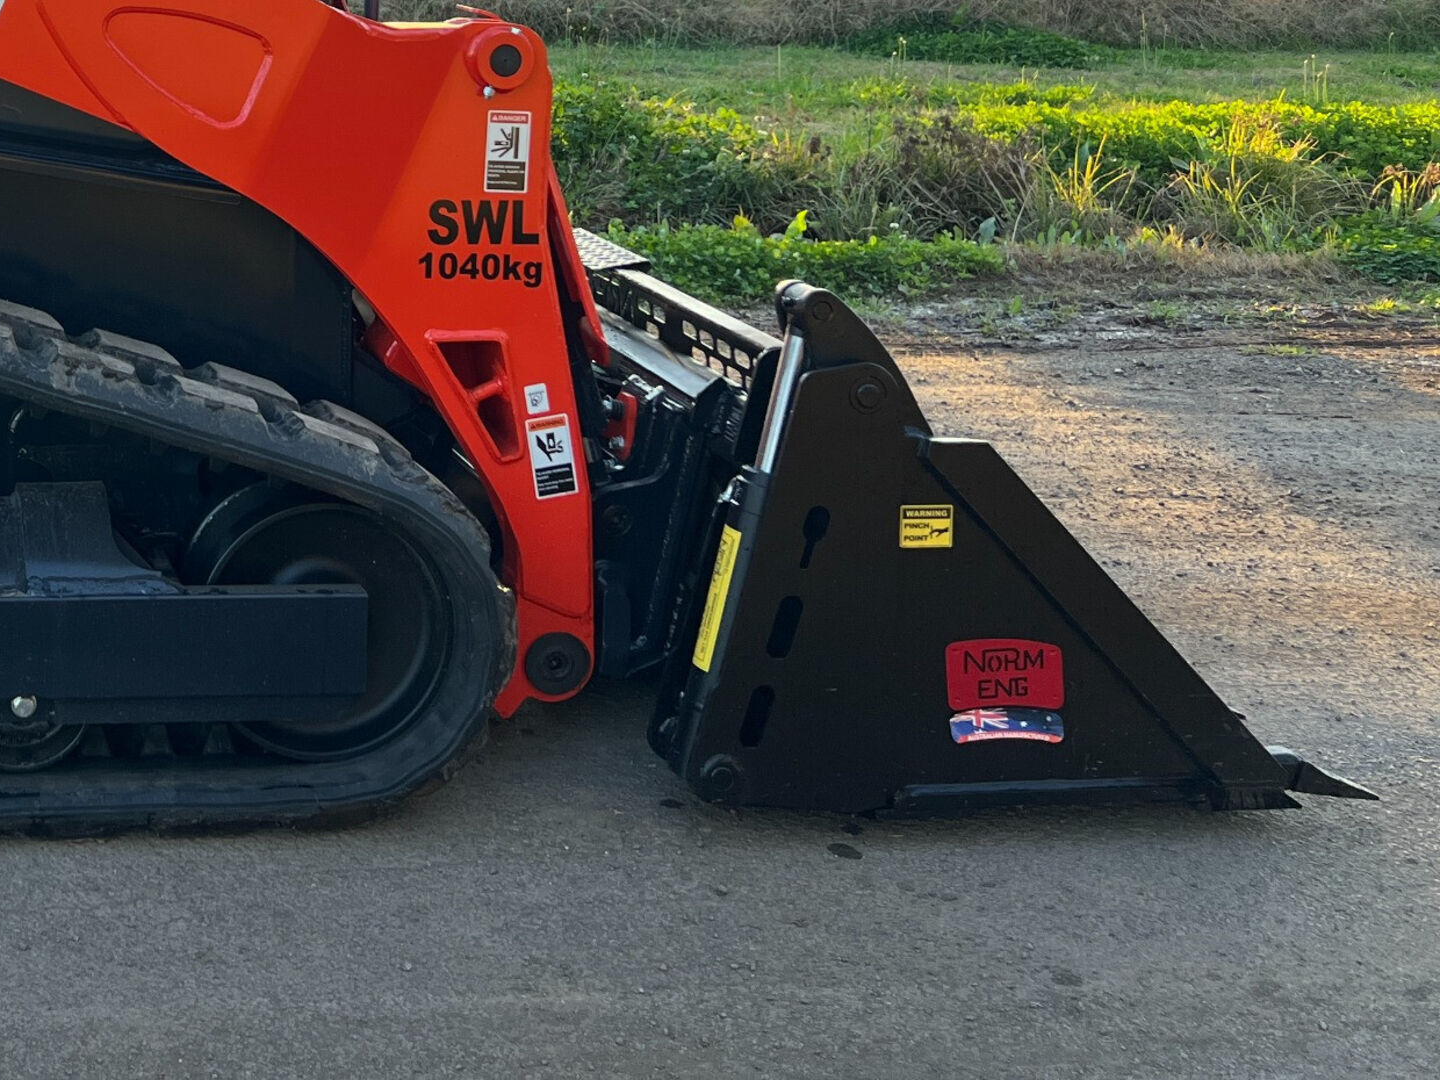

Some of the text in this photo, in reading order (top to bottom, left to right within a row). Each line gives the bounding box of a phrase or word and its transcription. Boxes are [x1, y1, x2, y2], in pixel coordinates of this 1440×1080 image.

[427, 199, 540, 246] SWL
[418, 252, 543, 288] 1040kg
[905, 510, 948, 518] WARNING
[978, 677, 1028, 699] ENG
